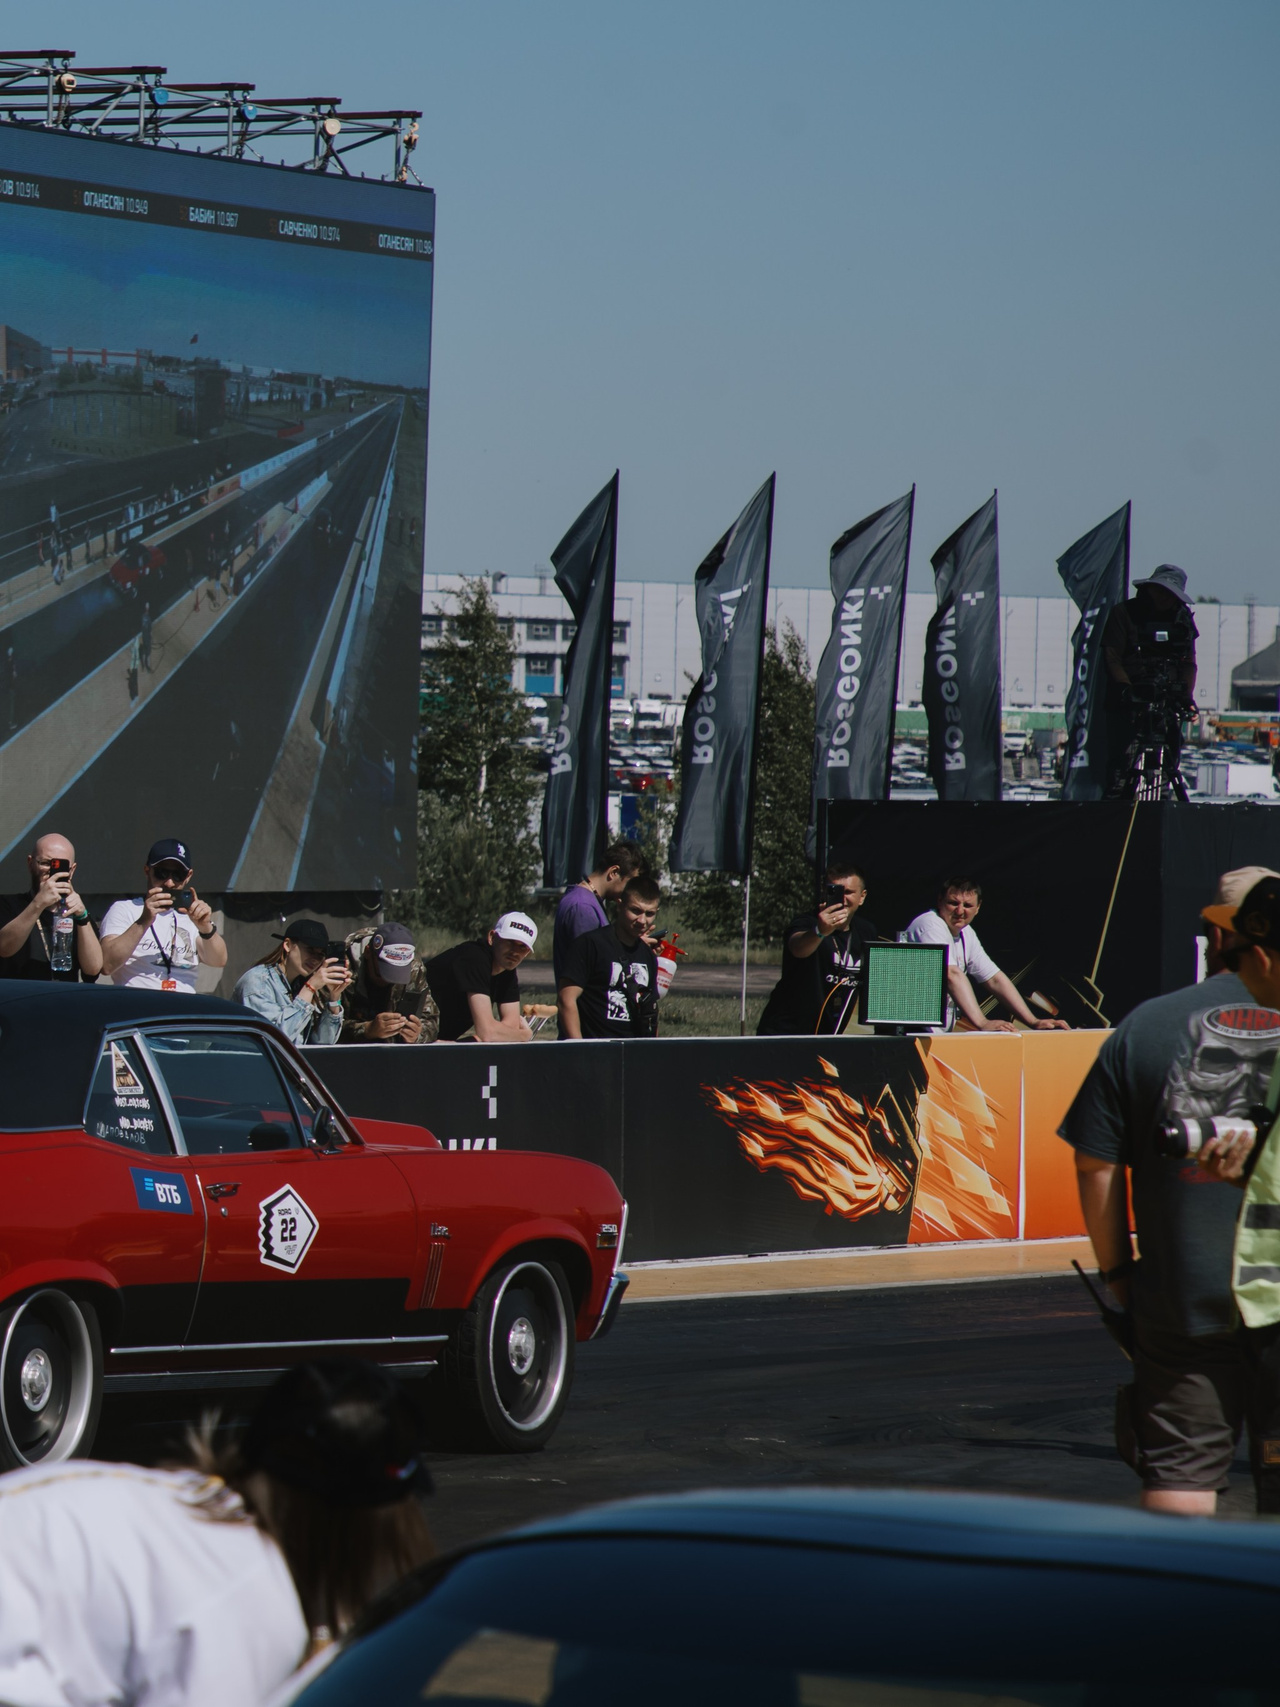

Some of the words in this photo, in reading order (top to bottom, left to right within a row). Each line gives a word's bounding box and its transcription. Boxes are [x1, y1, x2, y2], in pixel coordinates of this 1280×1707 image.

[15, 181, 40, 199] 10.914
[83, 191, 125, 211] ОГАНЕСЯН
[125, 196, 148, 215] 10.949
[188, 206, 216, 224] БАБИН
[217, 211, 239, 228] 10.967
[279, 219, 318, 239] САВЧЕНКО
[319, 225, 341, 242] 10.974
[378, 234, 414, 252] ОГАНЕСЯН
[154, 1183, 181, 1205] ВТБ
[280, 1217, 297, 1242] 22
[602, 1224, 618, 1233] 250
